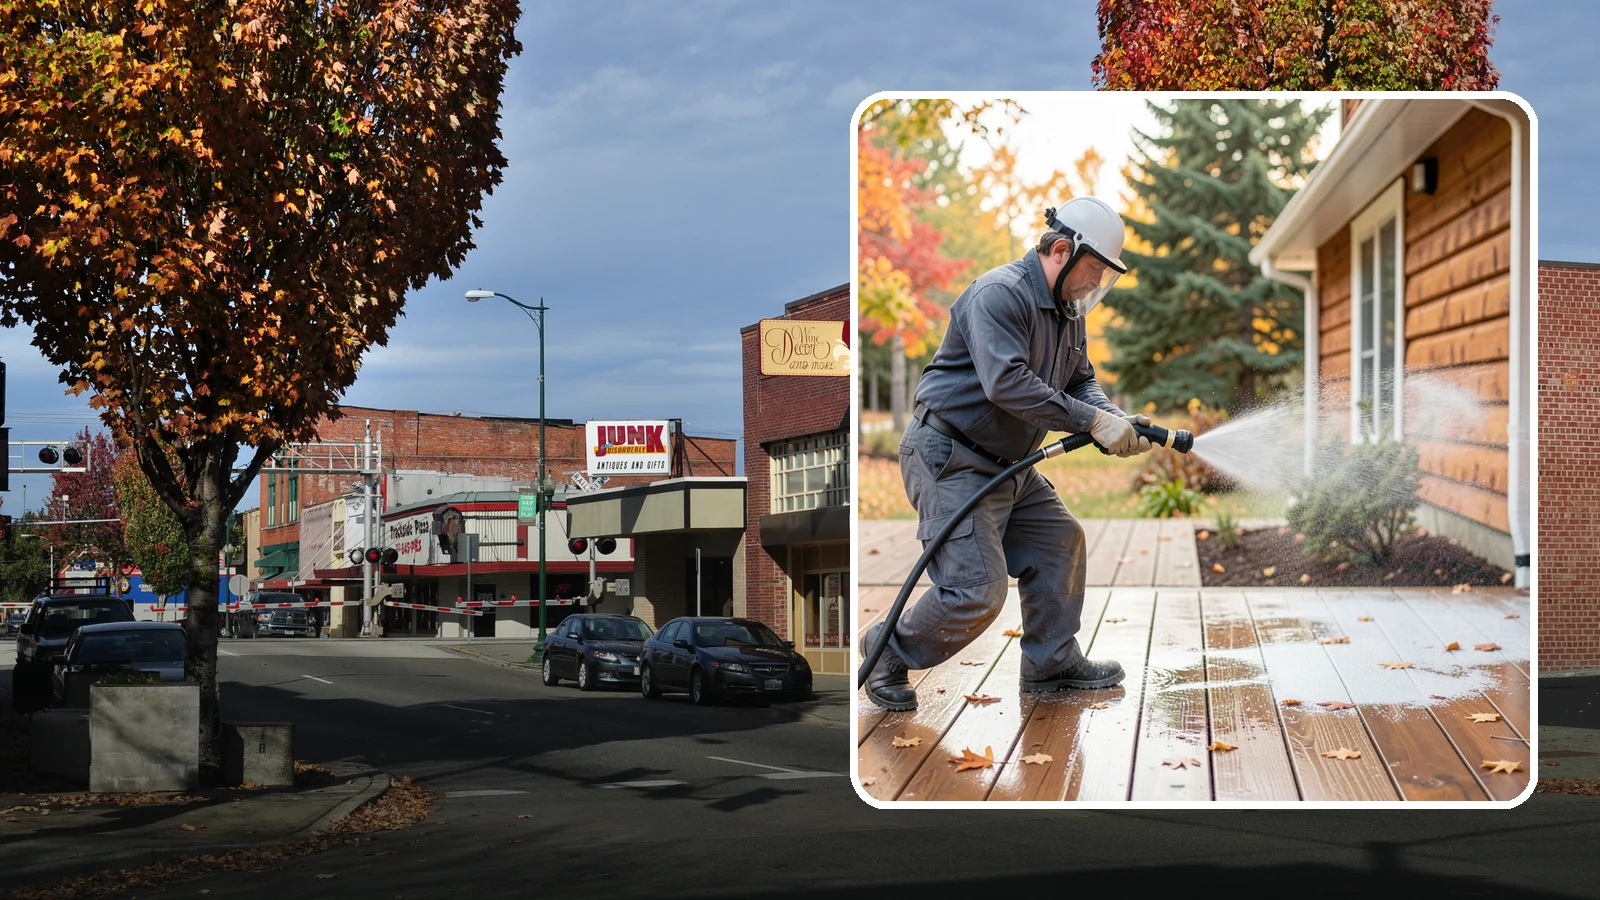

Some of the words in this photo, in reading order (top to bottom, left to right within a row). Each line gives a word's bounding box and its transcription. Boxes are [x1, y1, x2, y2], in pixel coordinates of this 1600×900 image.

[595, 425, 665, 457] JUNK
[607, 446, 646, 454] DISORDERLY
[596, 461, 629, 470] ANTIQUES
[631, 461, 645, 470] AND
[646, 460, 666, 470] GIFTS
